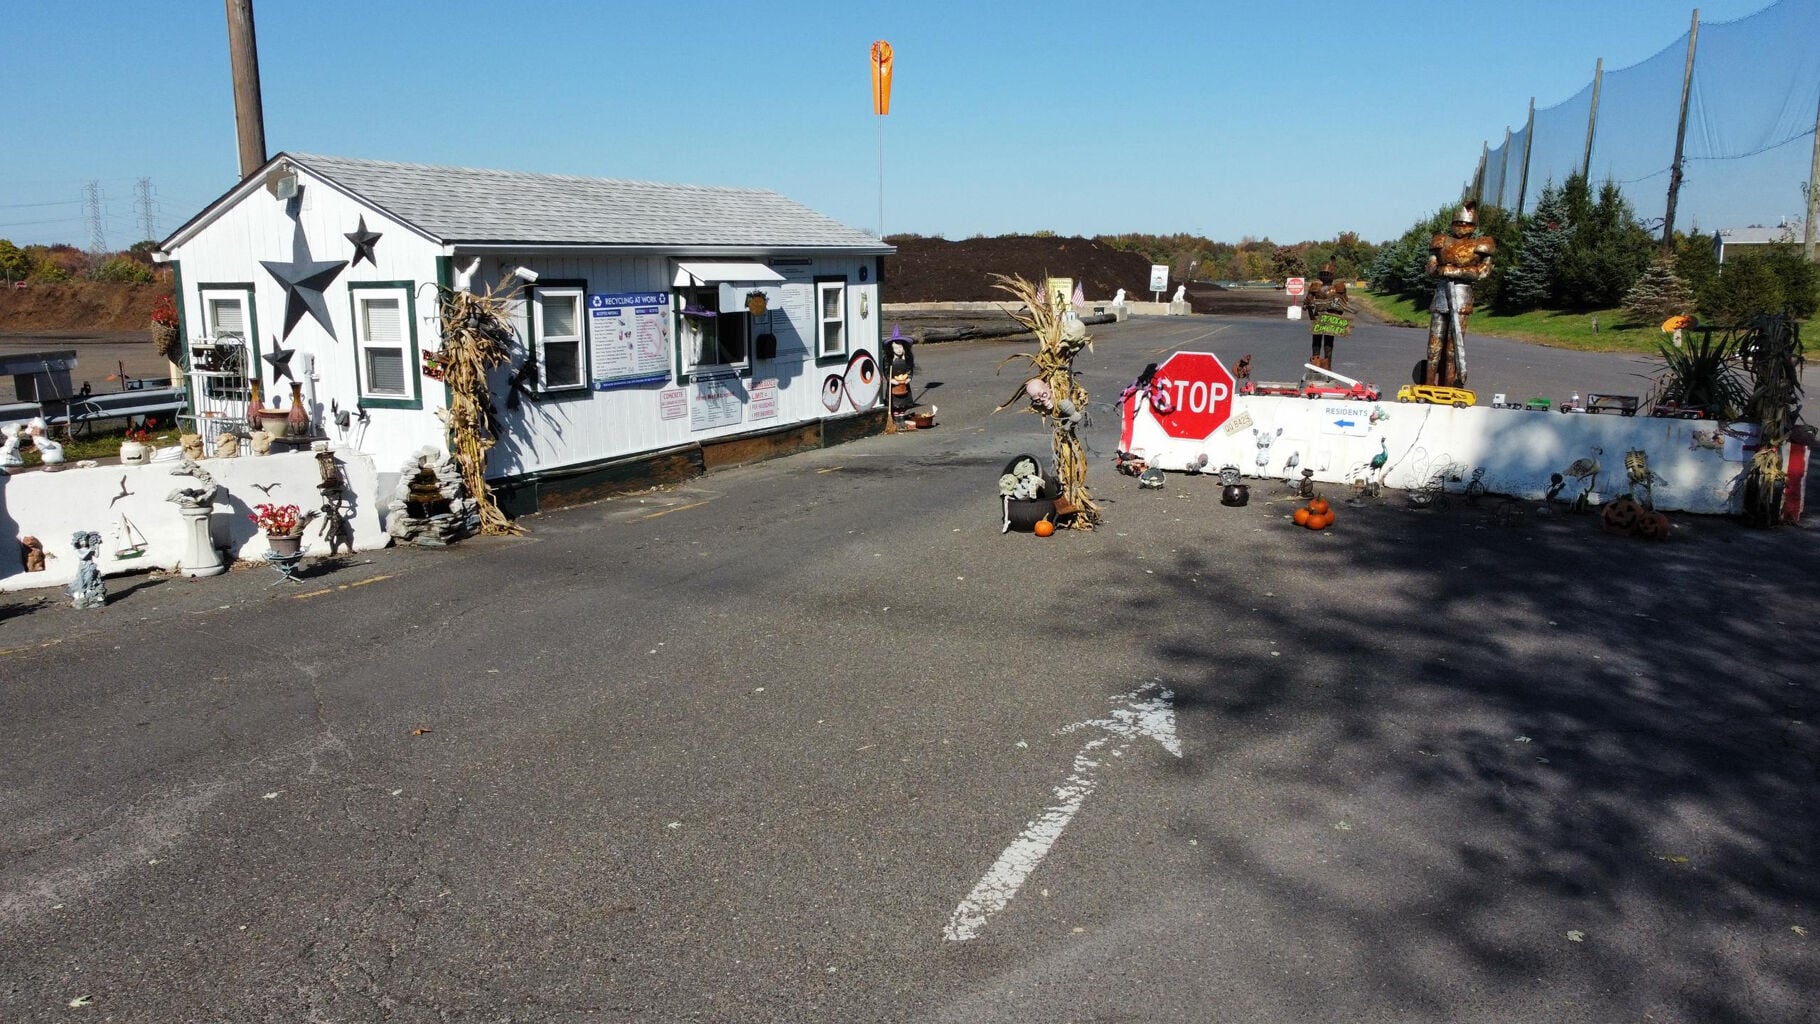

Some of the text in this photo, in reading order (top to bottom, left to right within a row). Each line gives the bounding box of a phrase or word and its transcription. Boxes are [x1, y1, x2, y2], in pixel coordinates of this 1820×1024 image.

[605, 297, 634, 305] RECYCLING
[641, 295, 658, 303] WORK
[663, 391, 683, 400] CONCRETE
[1159, 378, 1228, 414] STOP
[1325, 407, 1368, 416] RESIDENTS
